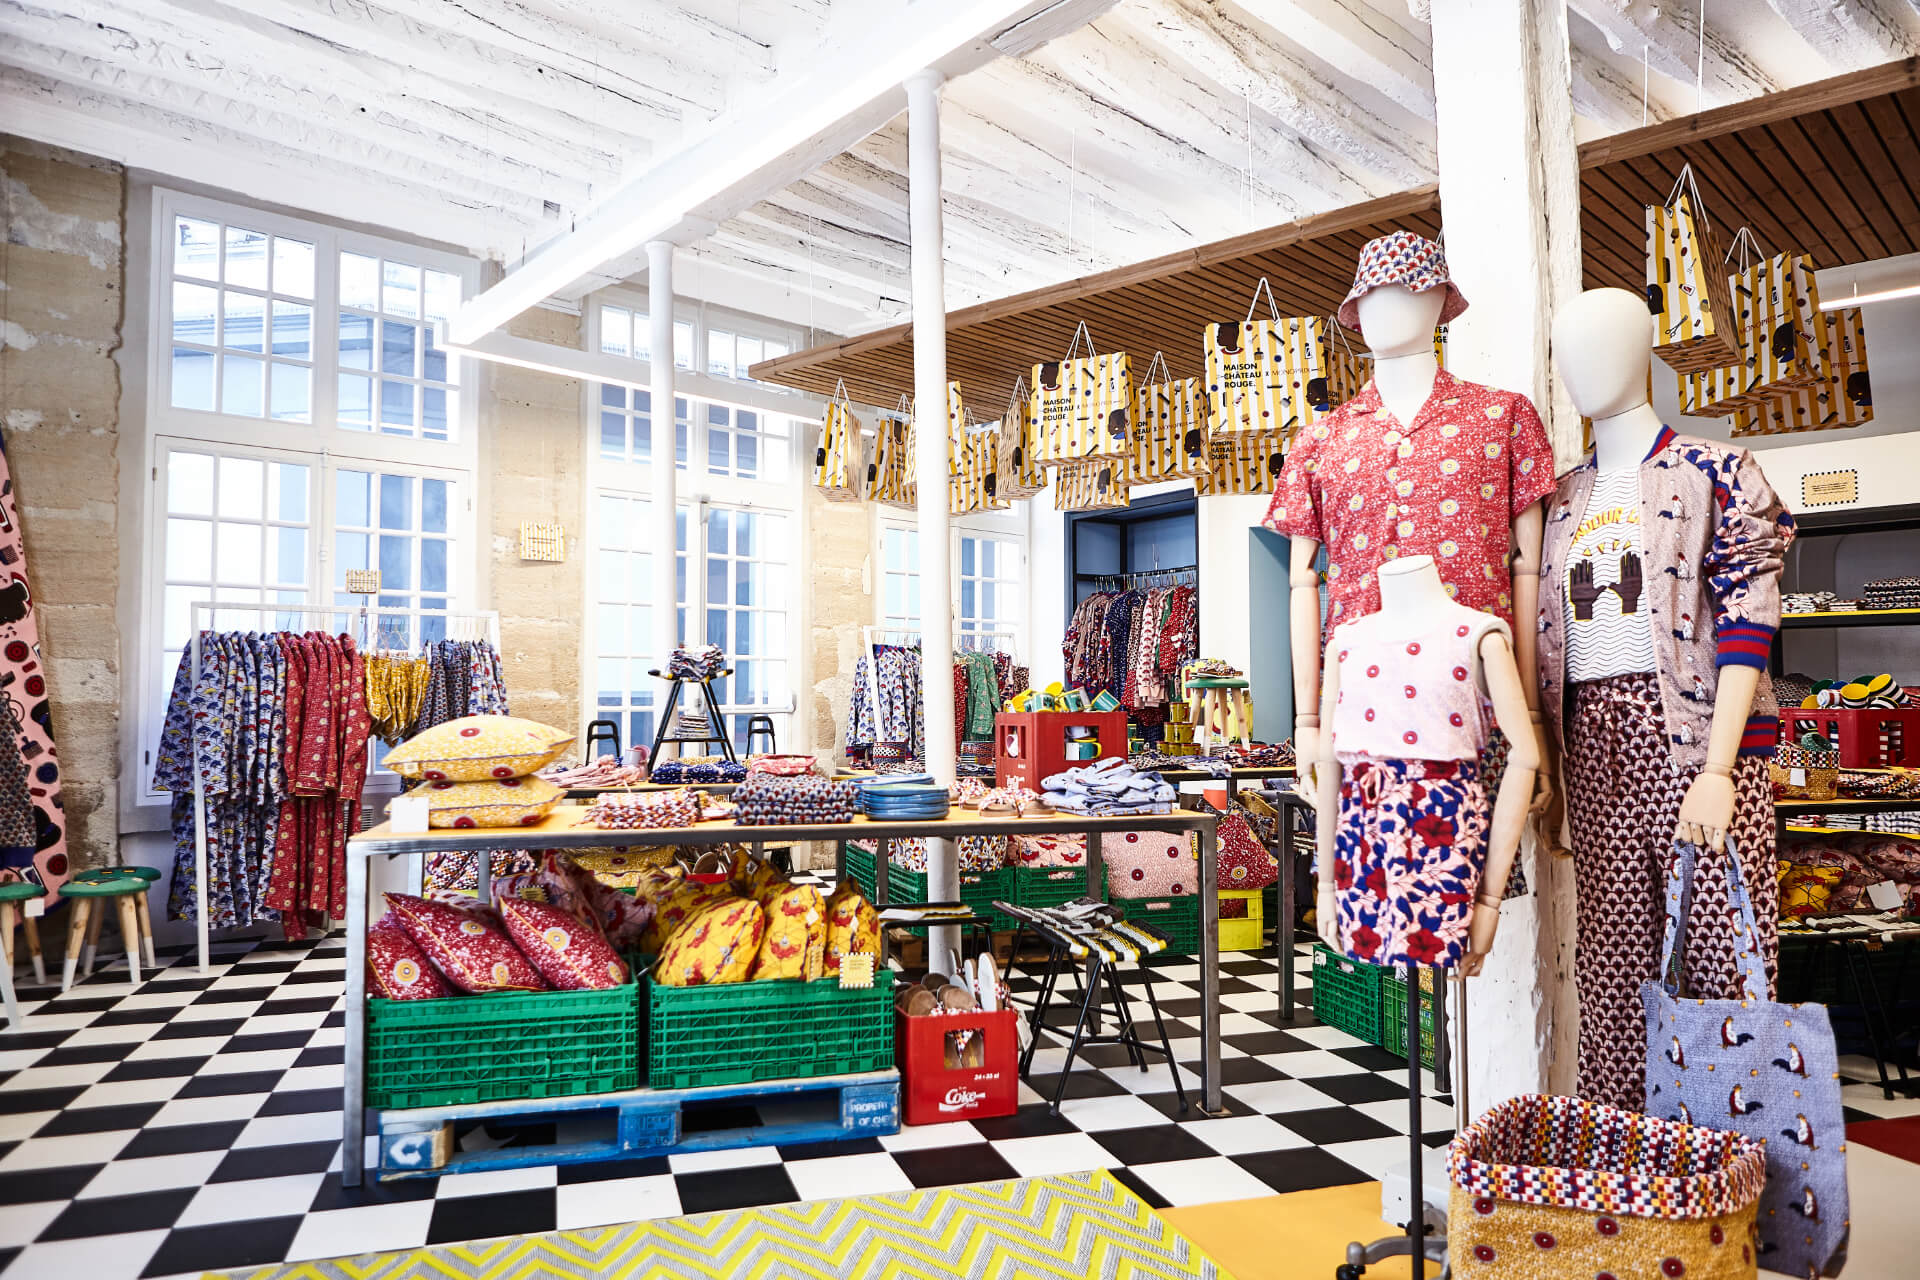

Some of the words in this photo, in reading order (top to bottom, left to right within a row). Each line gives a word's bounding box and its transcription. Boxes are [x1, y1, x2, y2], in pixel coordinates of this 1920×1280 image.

[1223, 363, 1258, 371] MAISON
[1223, 371, 1261, 380] CHÂTEAU
[1043, 398, 1071, 406] MAISON
[1043, 405, 1074, 414] CHÂTEAU
[943, 1088, 986, 1106] Coke
